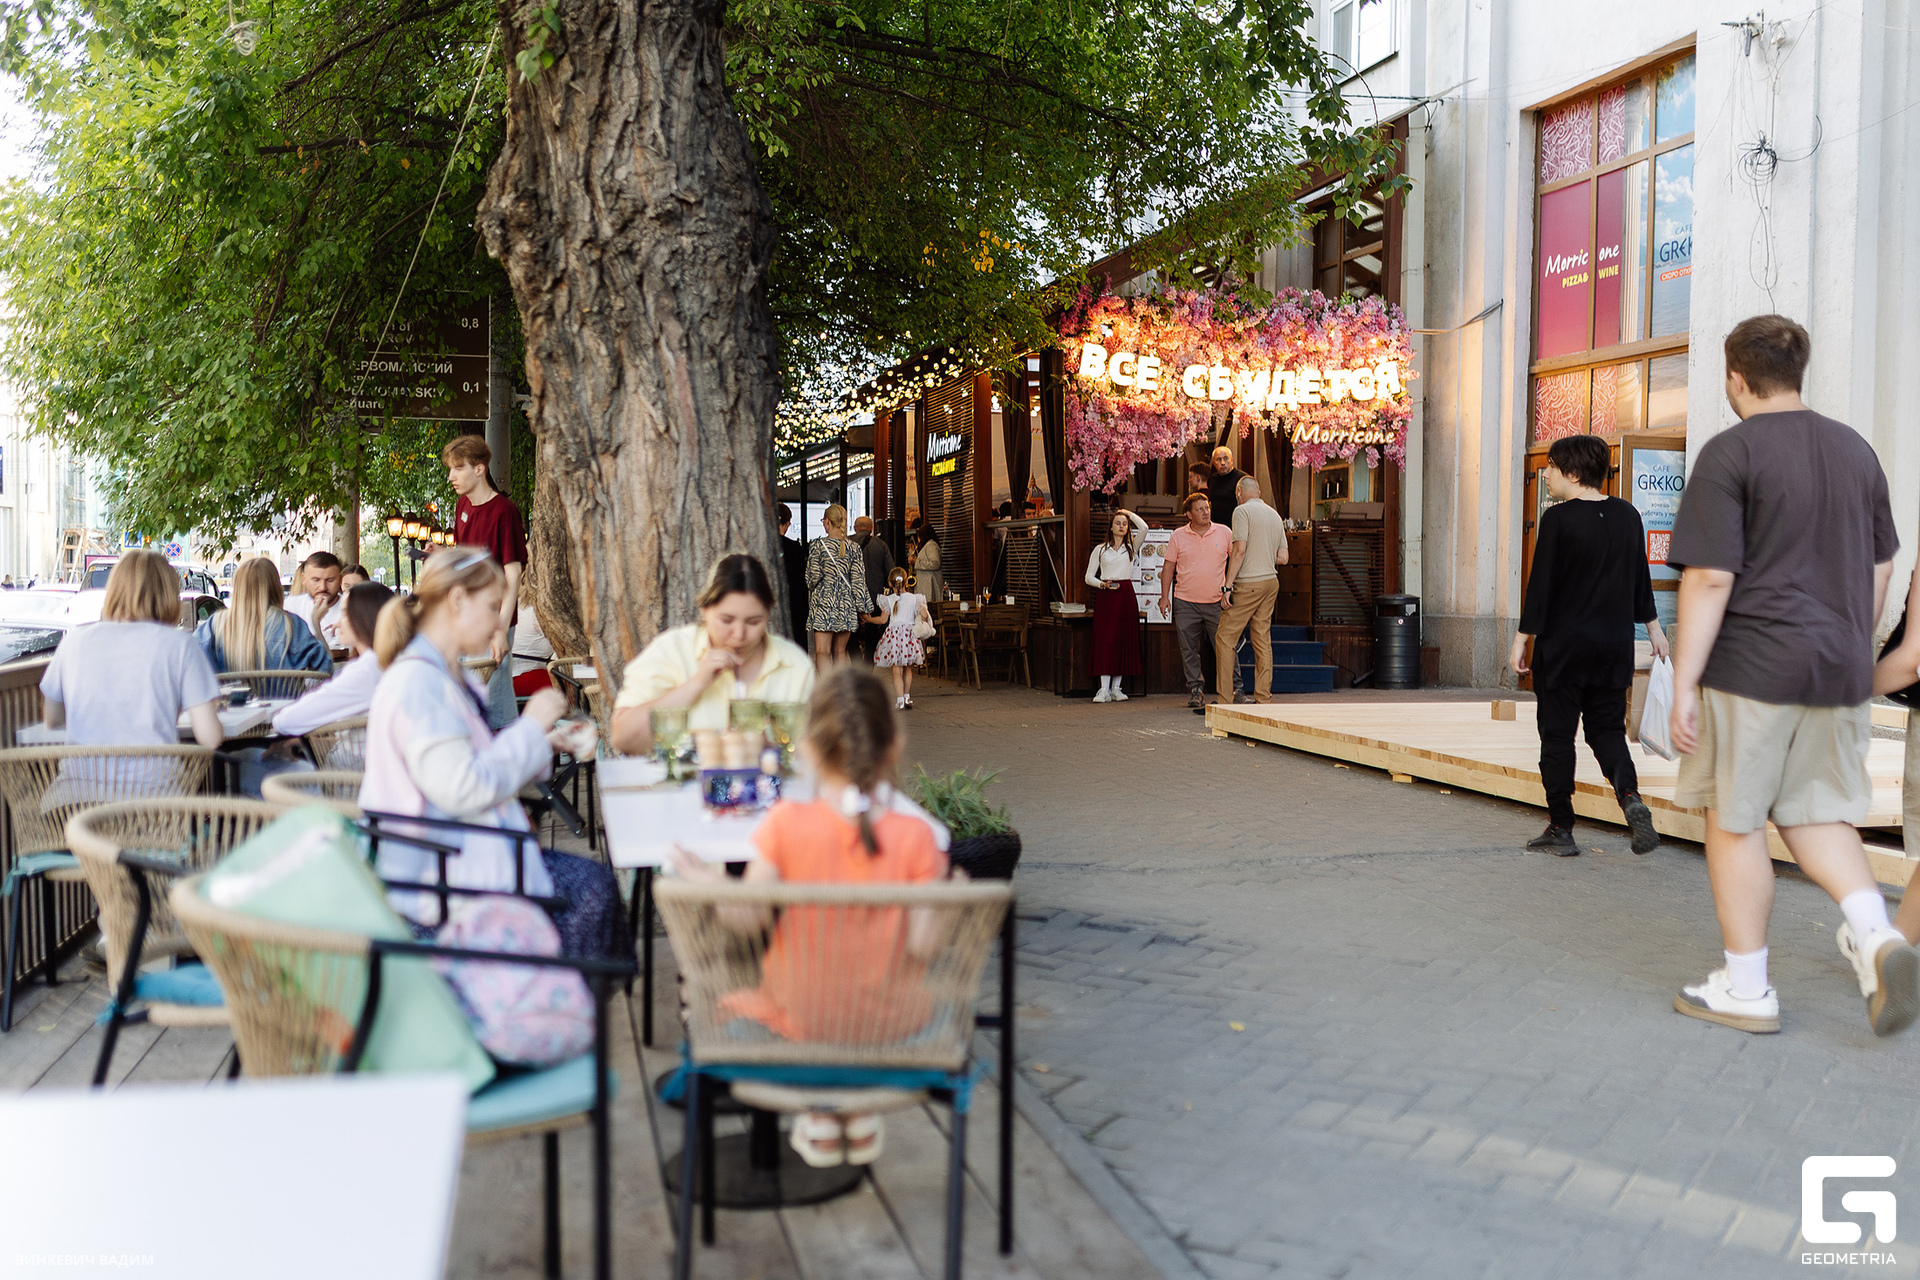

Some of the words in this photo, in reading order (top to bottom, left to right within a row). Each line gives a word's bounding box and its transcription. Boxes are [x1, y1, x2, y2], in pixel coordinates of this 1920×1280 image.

[1598, 264, 1619, 280] WINE
[1661, 270, 1679, 281] СКОРО
[461, 317, 479, 330] 0,8
[1079, 342, 1161, 390] ВСЕ
[1182, 361, 1401, 411] СБУДЕТСЯ
[462, 382, 480, 394] 0,1
[1290, 422, 1397, 444] Morricone
[1652, 464, 1670, 473] CAFE
